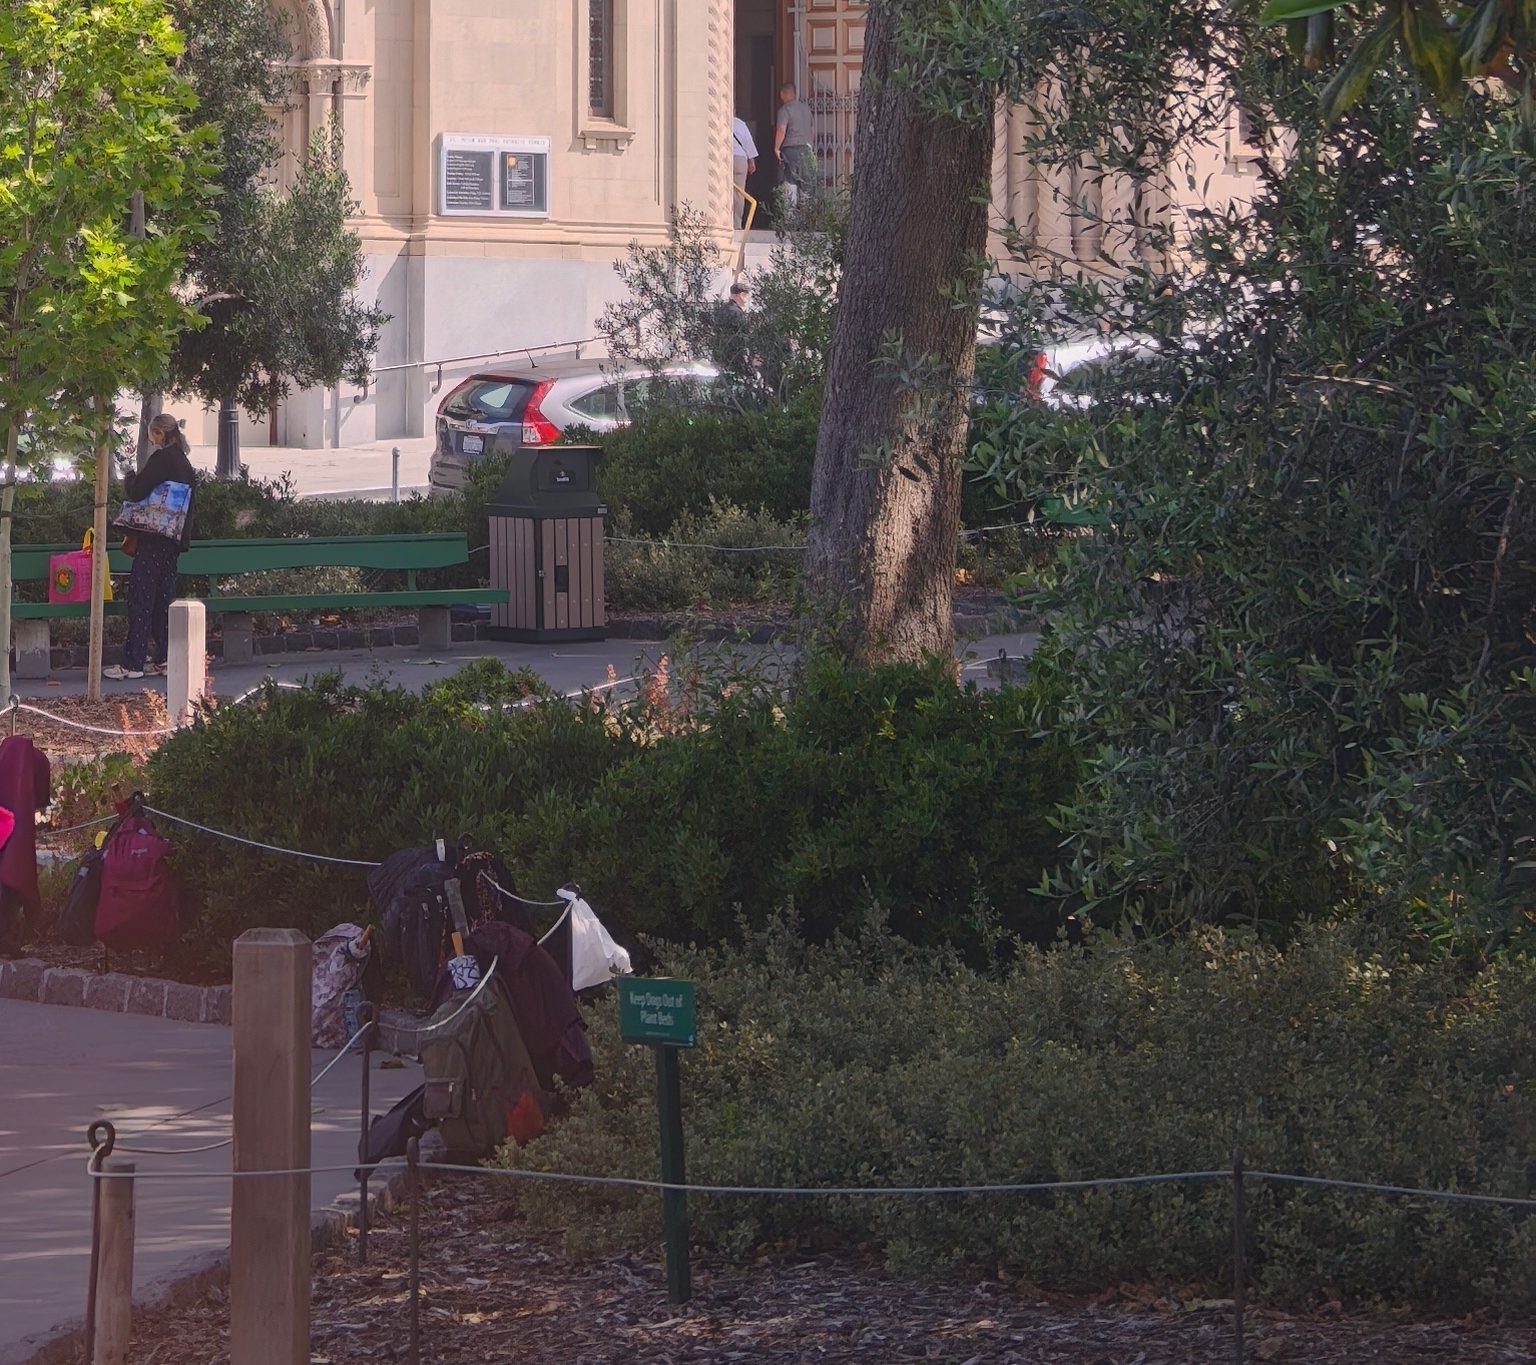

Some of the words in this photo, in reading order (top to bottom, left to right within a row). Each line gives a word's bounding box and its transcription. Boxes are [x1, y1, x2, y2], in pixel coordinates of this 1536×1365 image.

[629, 991, 646, 1009] Keep
[646, 992, 662, 1010] Dogs
[662, 993, 675, 1008] Out
[675, 994, 683, 1008] of
[640, 1010, 657, 1025] Plant
[657, 1011, 675, 1026] Beds
